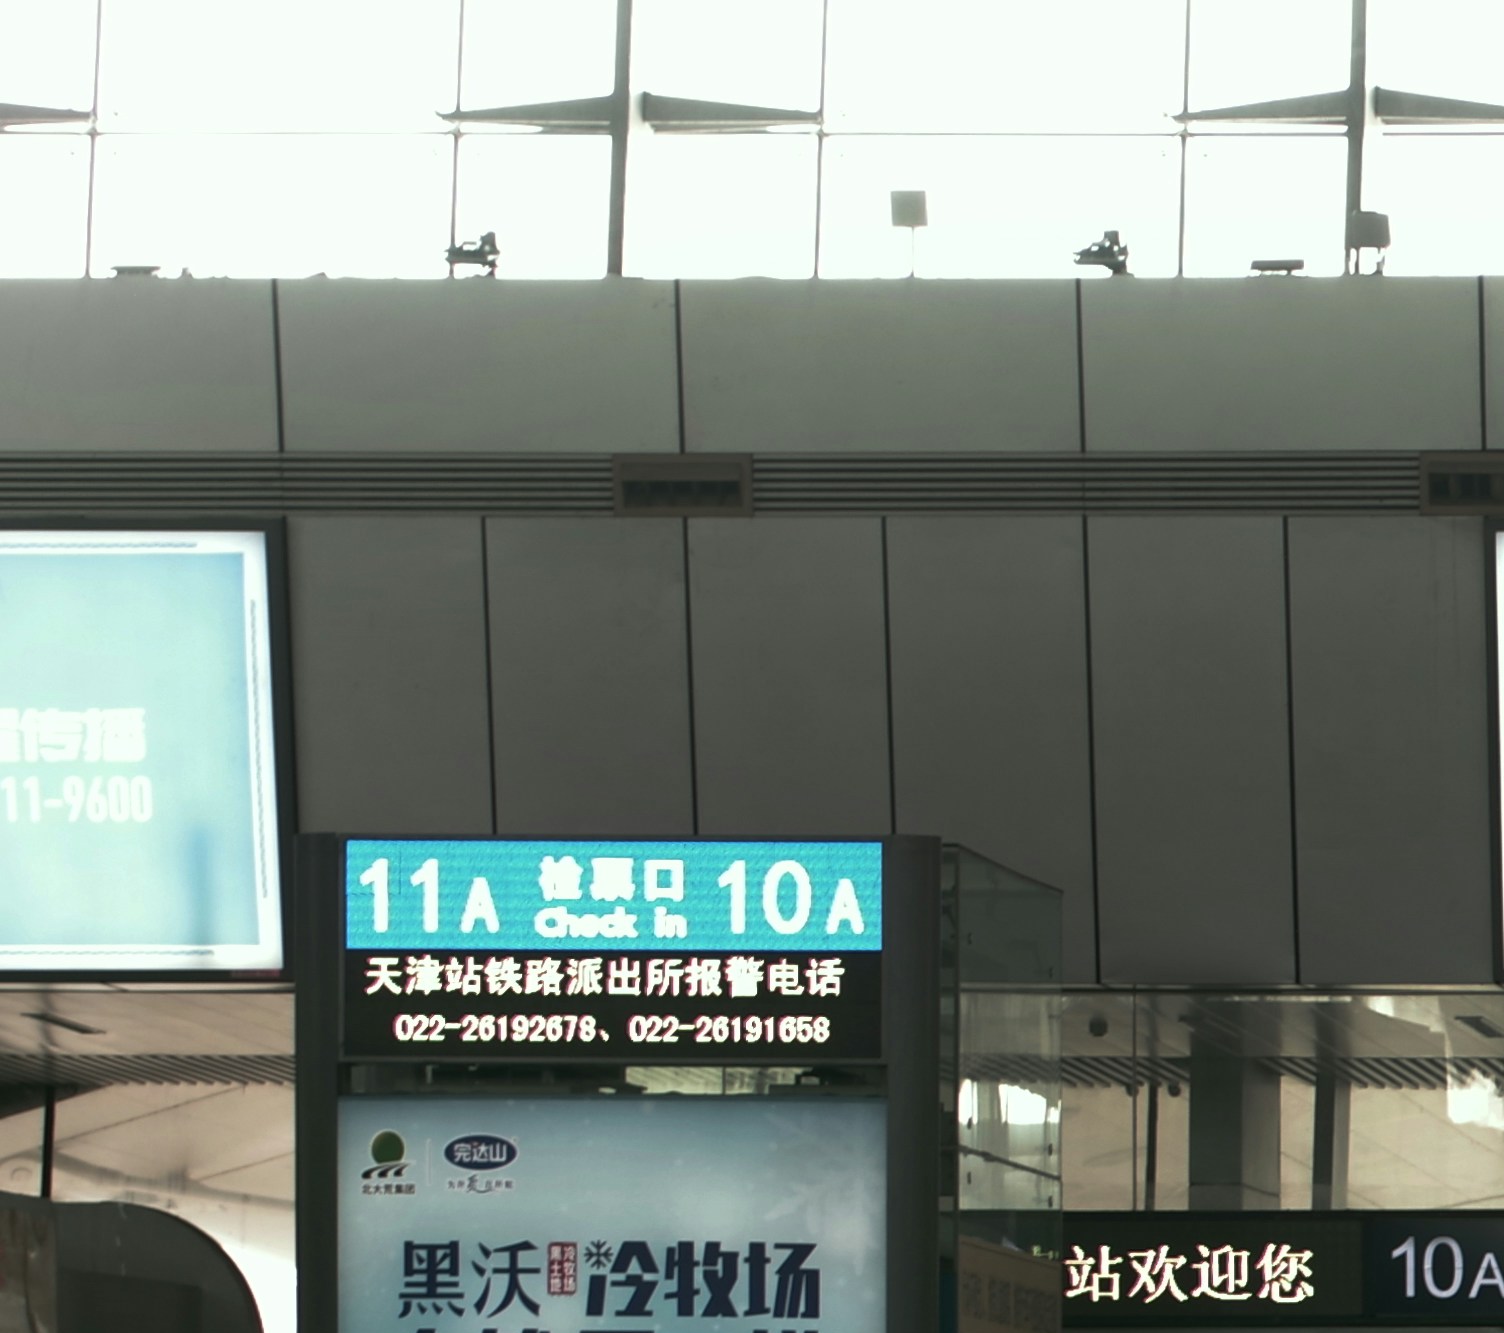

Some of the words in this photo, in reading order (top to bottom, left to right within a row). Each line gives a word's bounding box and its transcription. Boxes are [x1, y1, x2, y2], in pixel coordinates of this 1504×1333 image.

[359, 857, 500, 934] 11A
[538, 855, 685, 903] 检票口
[717, 859, 865, 936] 10A
[534, 905, 639, 939] Check
[653, 906, 688, 939] in
[365, 956, 845, 999] 天津站铁路派出所报警电话
[453, 1142, 507, 1163] 完达山
[399, 1239, 541, 1319] 黑沃
[583, 1239, 821, 1319] 冷牧场
[1064, 1243, 1315, 1304] 站欢迎您
